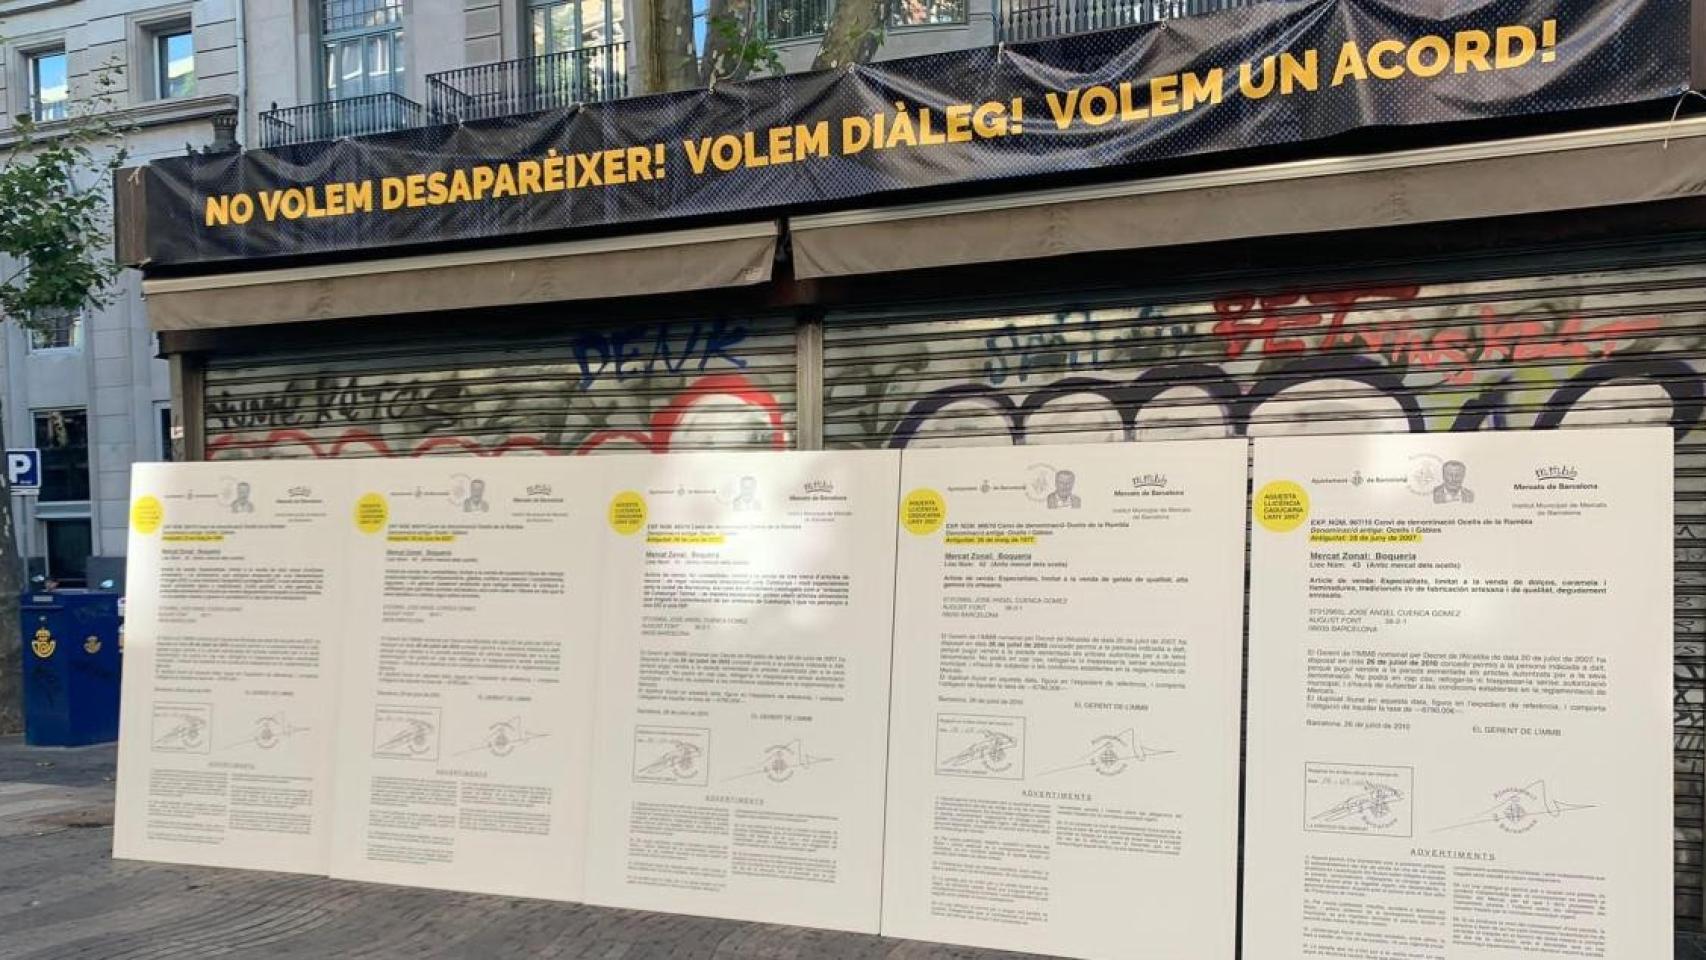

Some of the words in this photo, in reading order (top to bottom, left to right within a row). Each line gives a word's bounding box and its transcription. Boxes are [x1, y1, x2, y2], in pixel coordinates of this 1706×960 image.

[206, 194, 253, 225] NO
[260, 179, 373, 220] VOLEM
[684, 122, 829, 174] VOLEM
[842, 98, 1023, 154] DIÀLEG!
[1047, 69, 1224, 130] VOLEM
[1239, 50, 1318, 99] UN
[1330, 19, 1557, 86] ACORD!
[9, 454, 32, 483] P
[1411, 848, 1496, 861] ADVERTIMENTS
